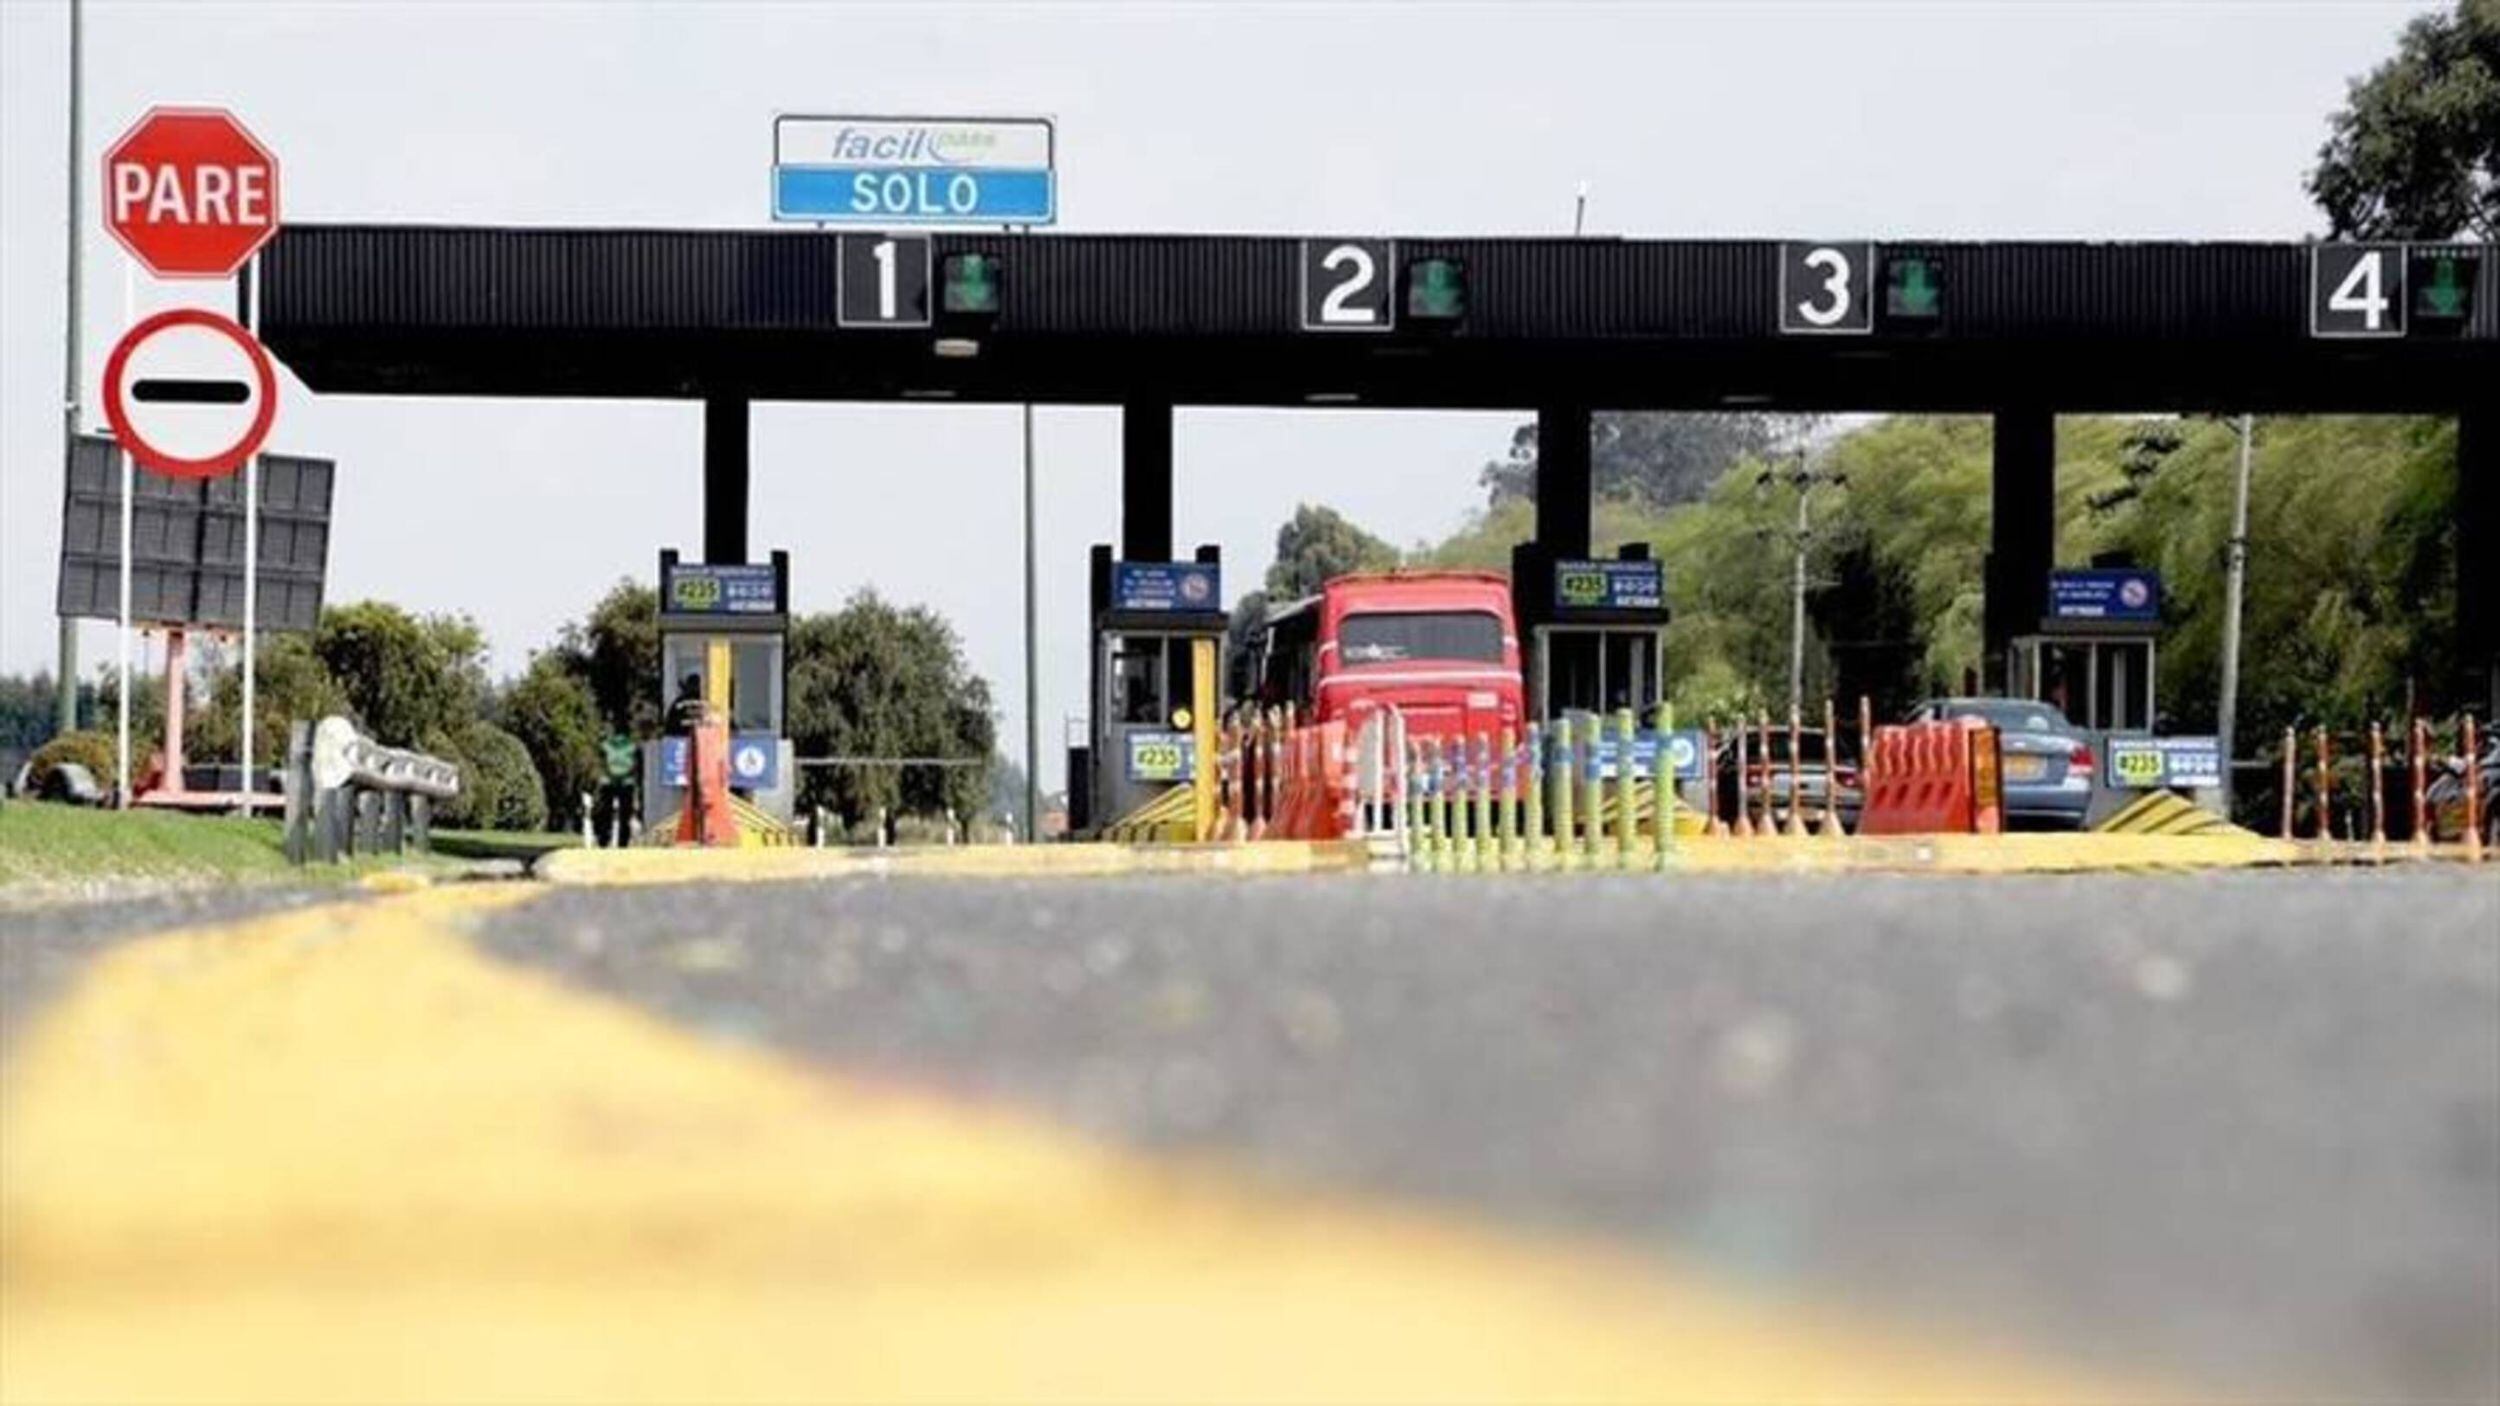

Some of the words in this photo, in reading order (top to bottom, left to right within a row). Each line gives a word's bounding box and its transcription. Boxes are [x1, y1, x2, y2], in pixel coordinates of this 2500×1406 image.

[833, 127, 927, 159] facil
[114, 162, 267, 225] PARE
[851, 172, 979, 213] SOLO
[873, 241, 896, 320] 1
[1322, 243, 1376, 323] 2
[1798, 247, 1850, 326] 3
[2328, 250, 2390, 330] 4
